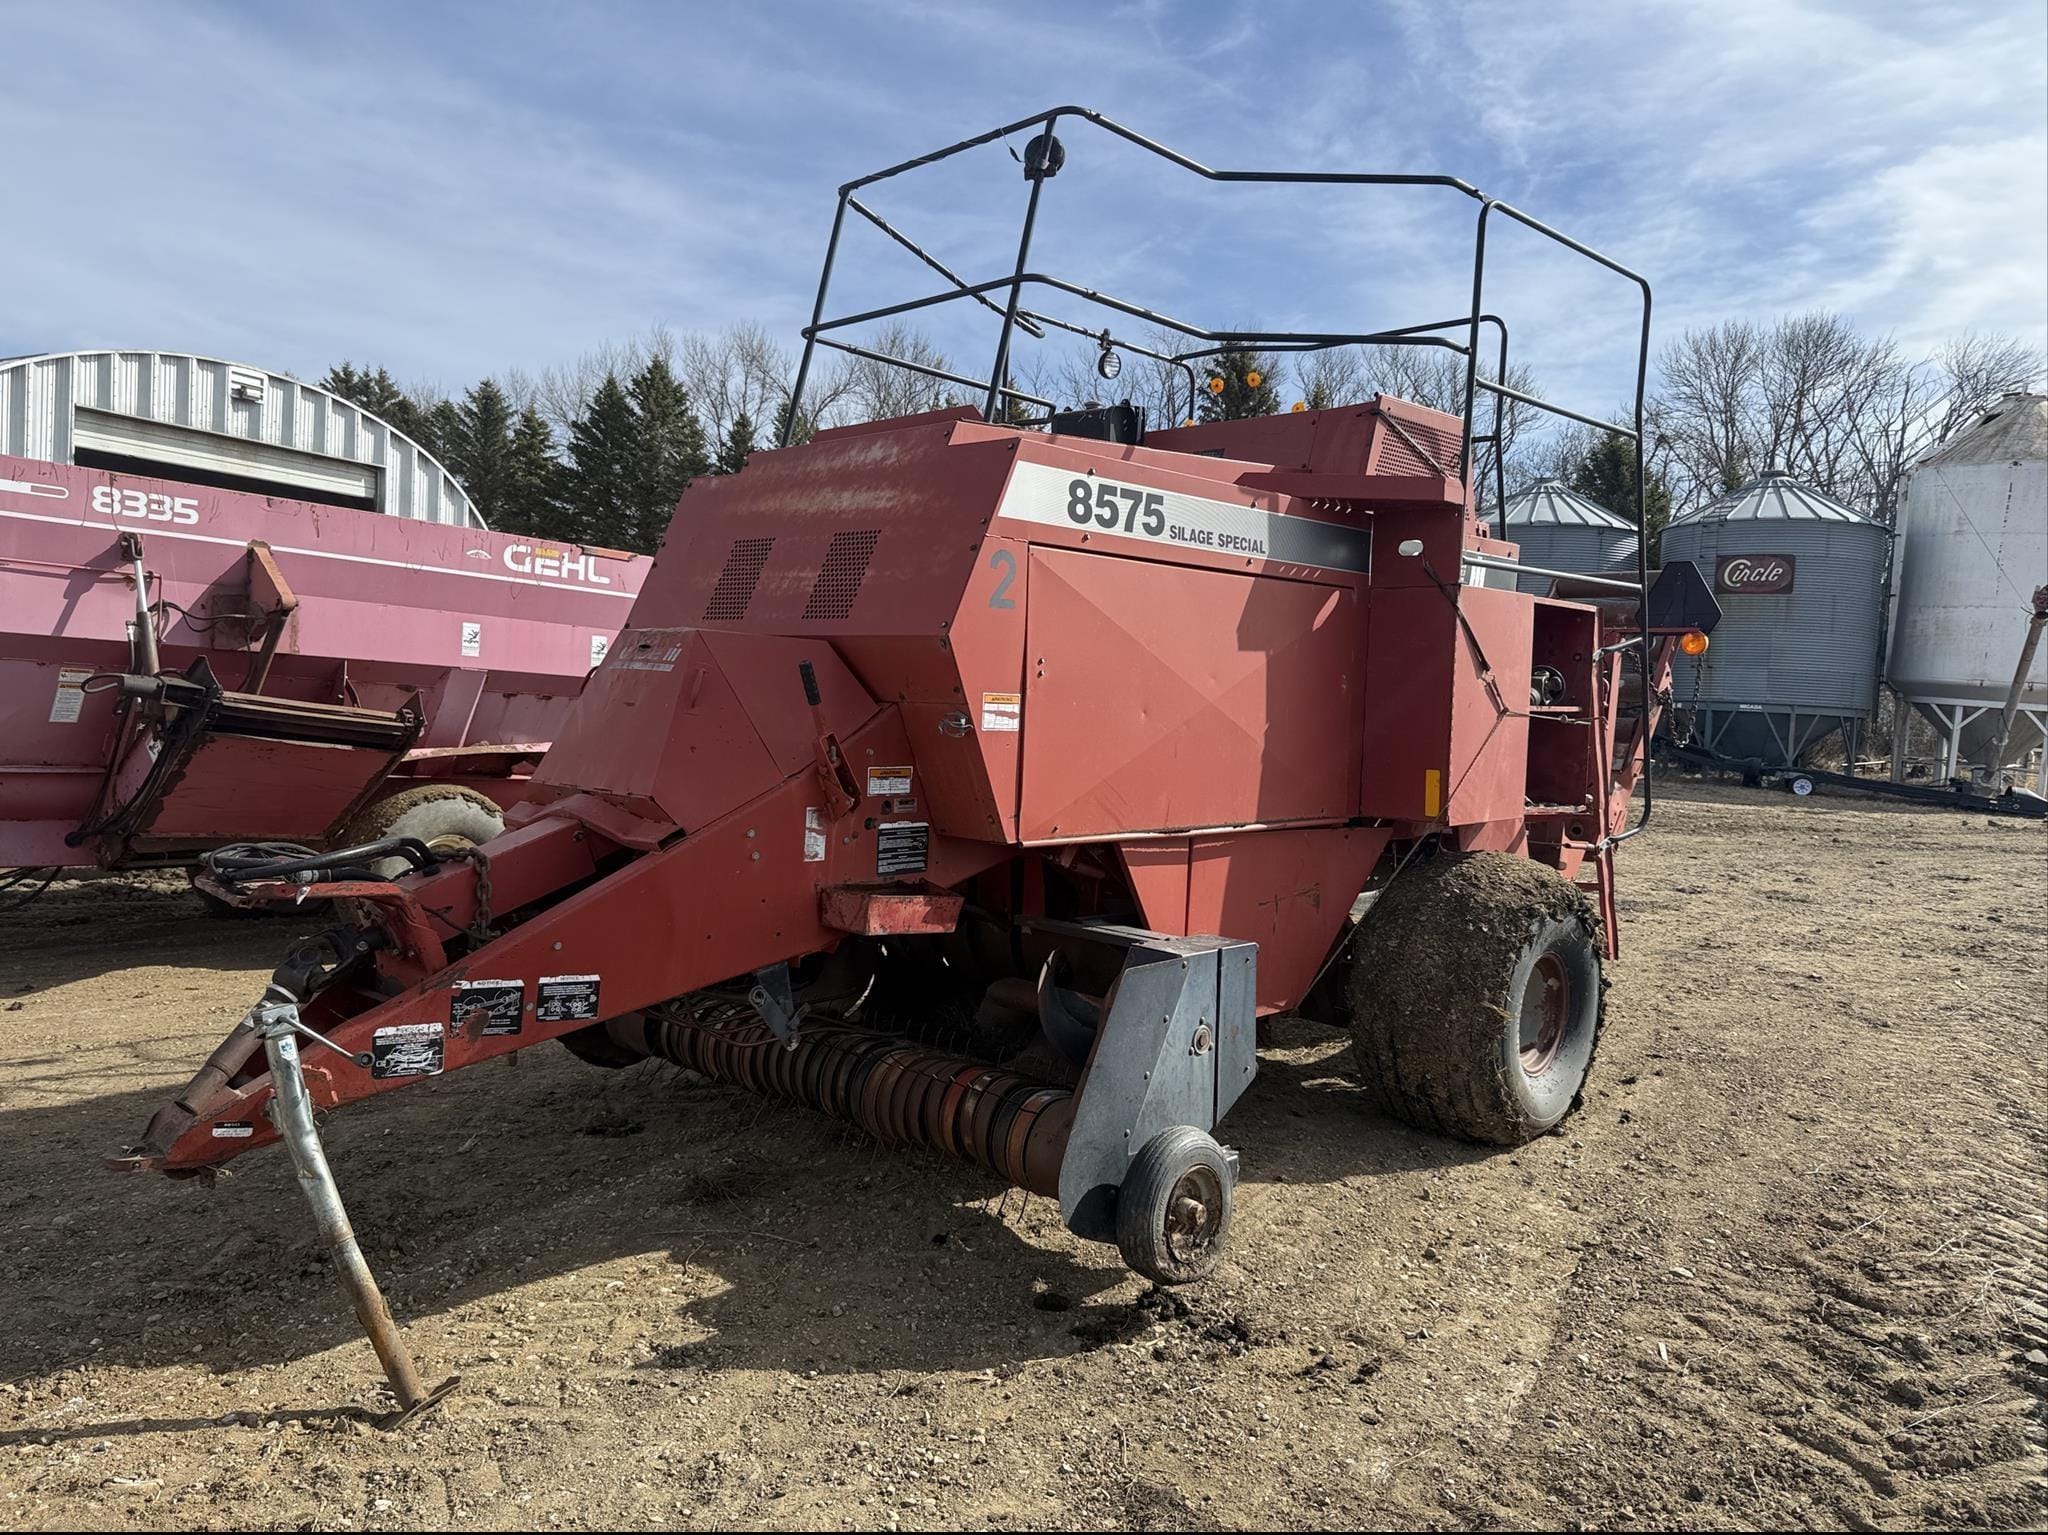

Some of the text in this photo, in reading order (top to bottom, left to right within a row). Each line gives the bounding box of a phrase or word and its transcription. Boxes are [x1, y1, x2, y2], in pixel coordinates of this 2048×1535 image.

[92, 485, 199, 525] 8335
[1067, 479, 1267, 554] 8575 SILAGE SPECIAL
[503, 544, 611, 584] GEHL
[988, 548, 1017, 609] 2
[1724, 559, 1784, 588] Circle
